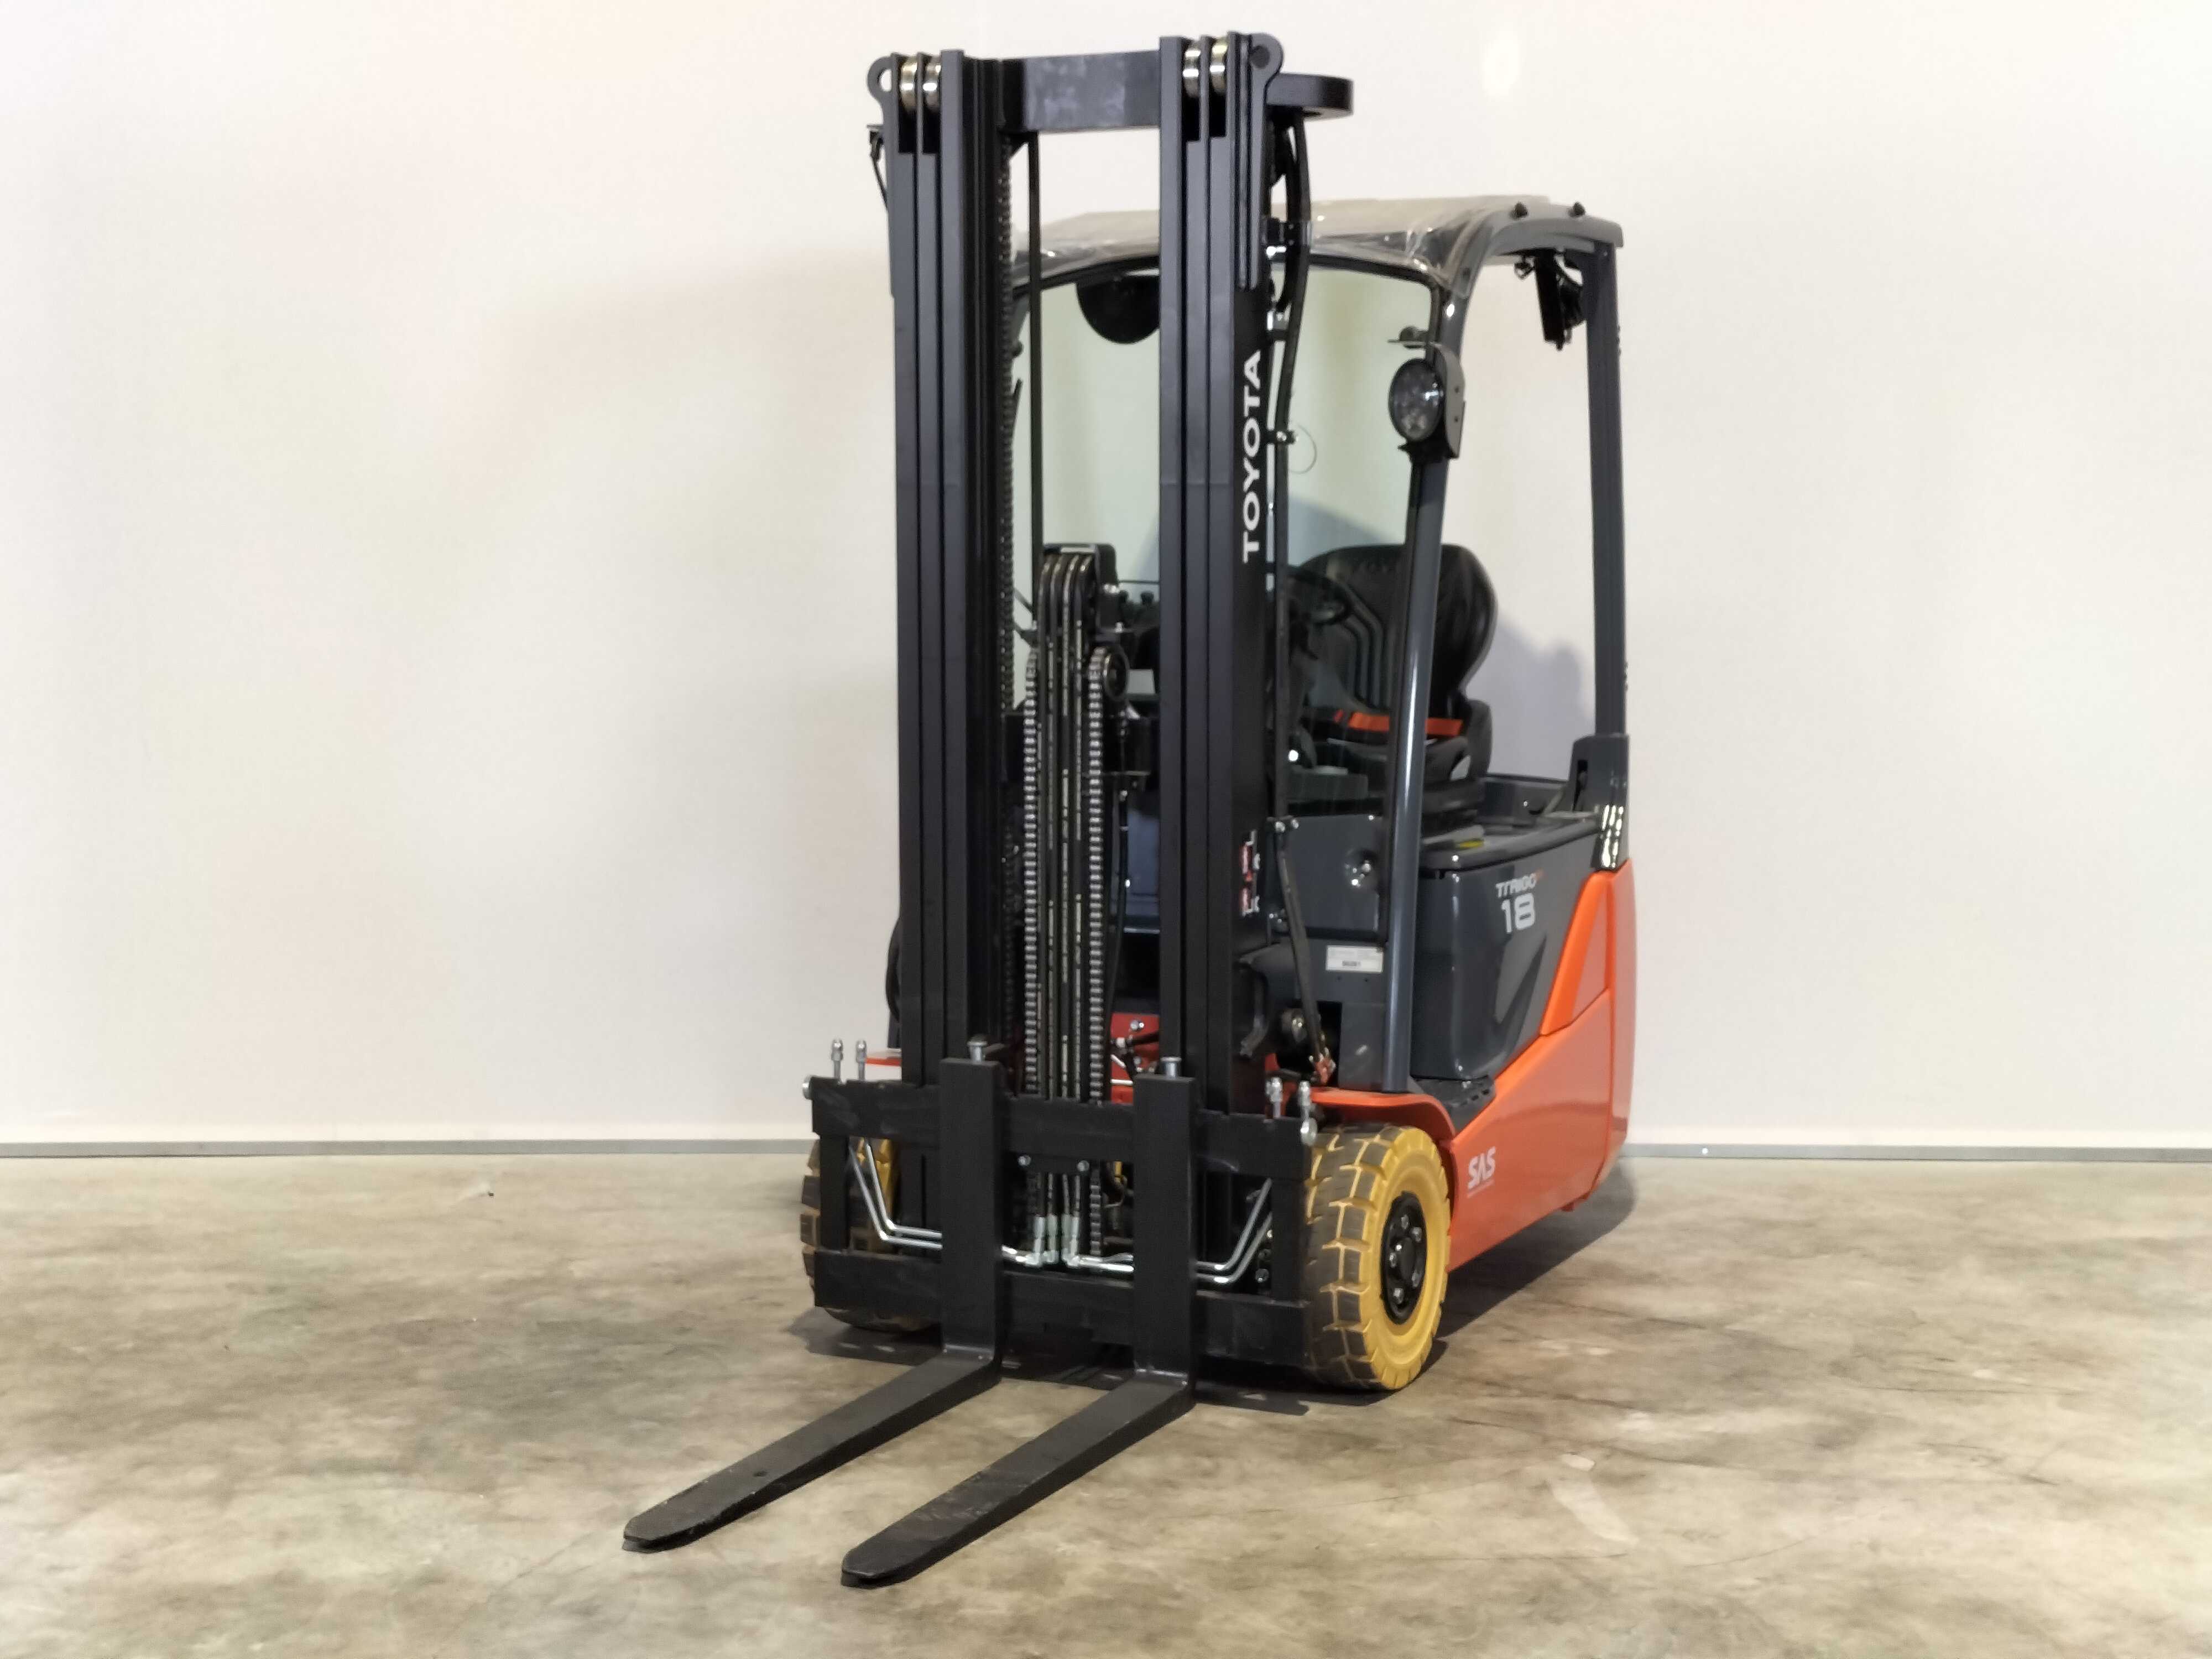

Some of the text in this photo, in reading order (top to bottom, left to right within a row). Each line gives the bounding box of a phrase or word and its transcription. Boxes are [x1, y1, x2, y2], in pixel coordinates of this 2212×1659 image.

[1243, 349, 1261, 564] TOYOTA
[1501, 893, 1535, 933] 18
[1468, 1146, 1495, 1190] SAS
